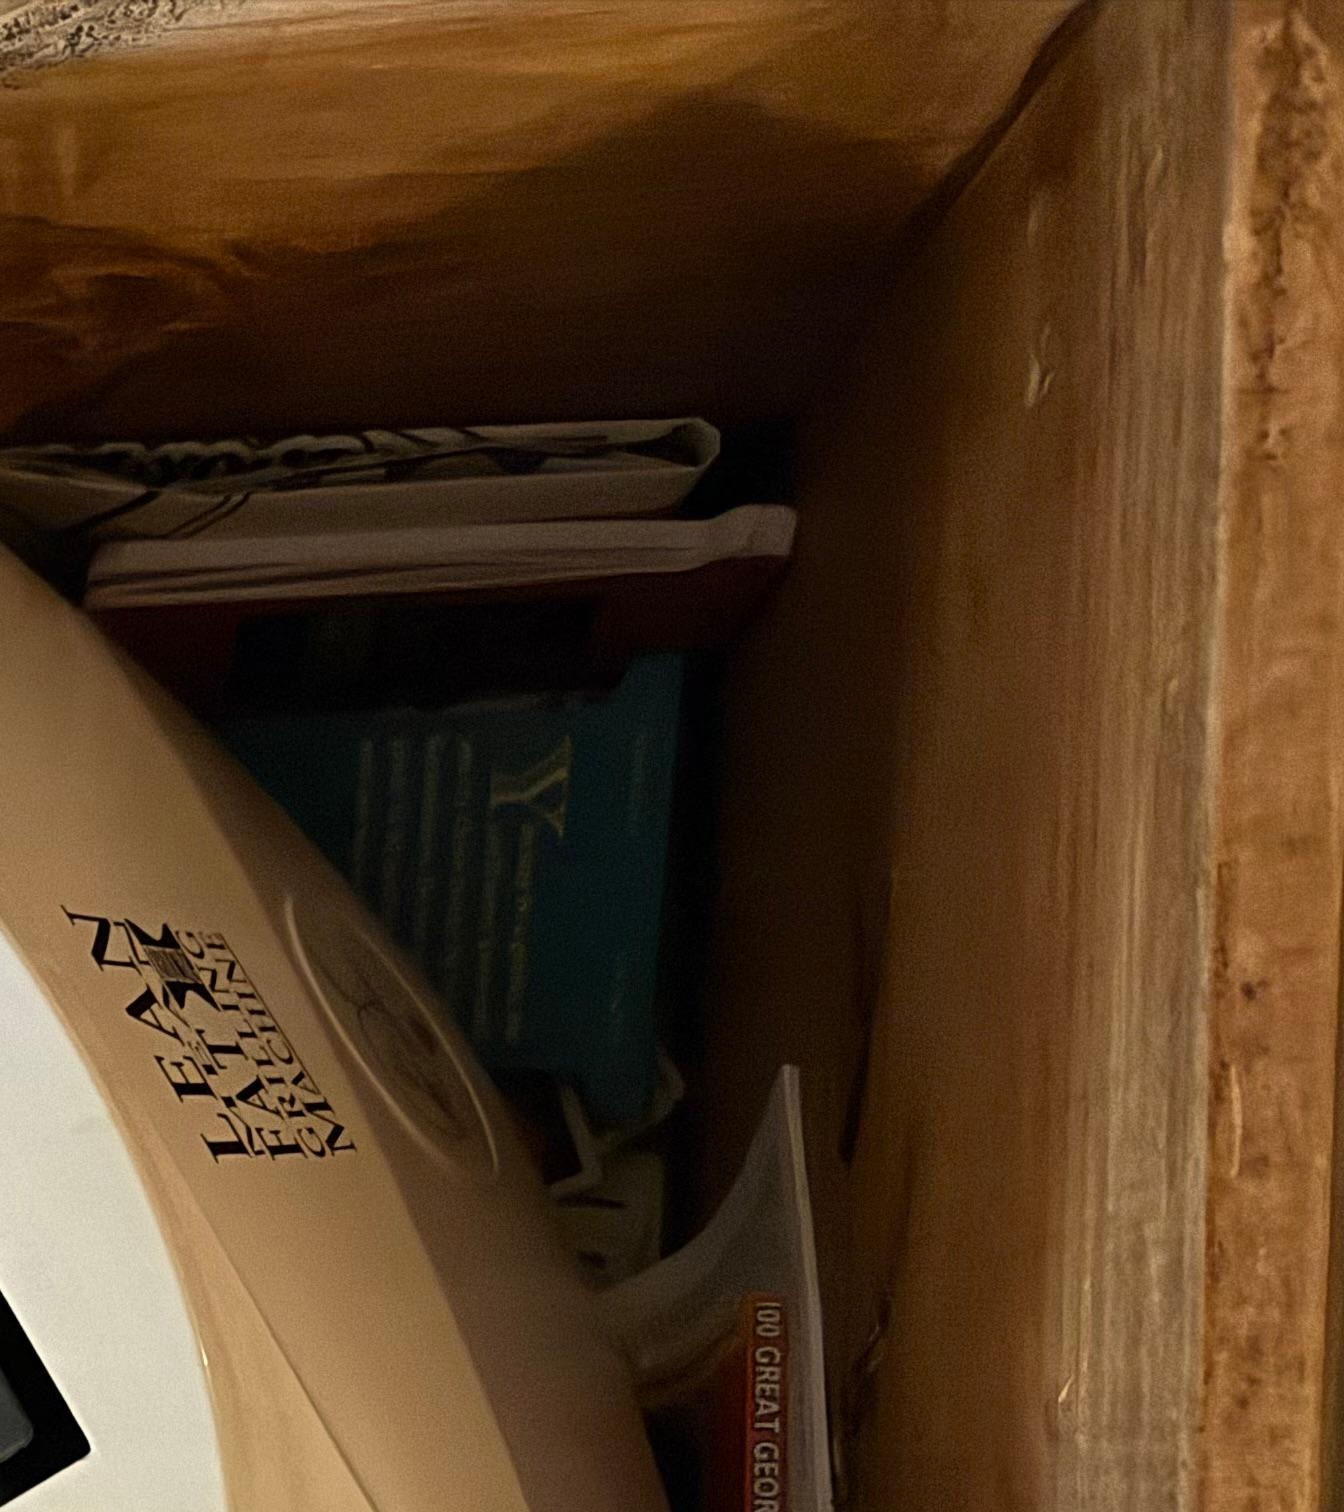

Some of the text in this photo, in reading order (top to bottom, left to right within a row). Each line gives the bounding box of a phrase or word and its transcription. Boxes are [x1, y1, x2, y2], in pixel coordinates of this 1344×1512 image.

[59, 903, 252, 1163] LEAN
[173, 929, 330, 1158] GRILLING
[193, 1028, 308, 1160] FAT
[195, 929, 358, 1156] MACHINE
[752, 1345, 781, 1434] GREAT
[754, 1301, 781, 1337] 100
